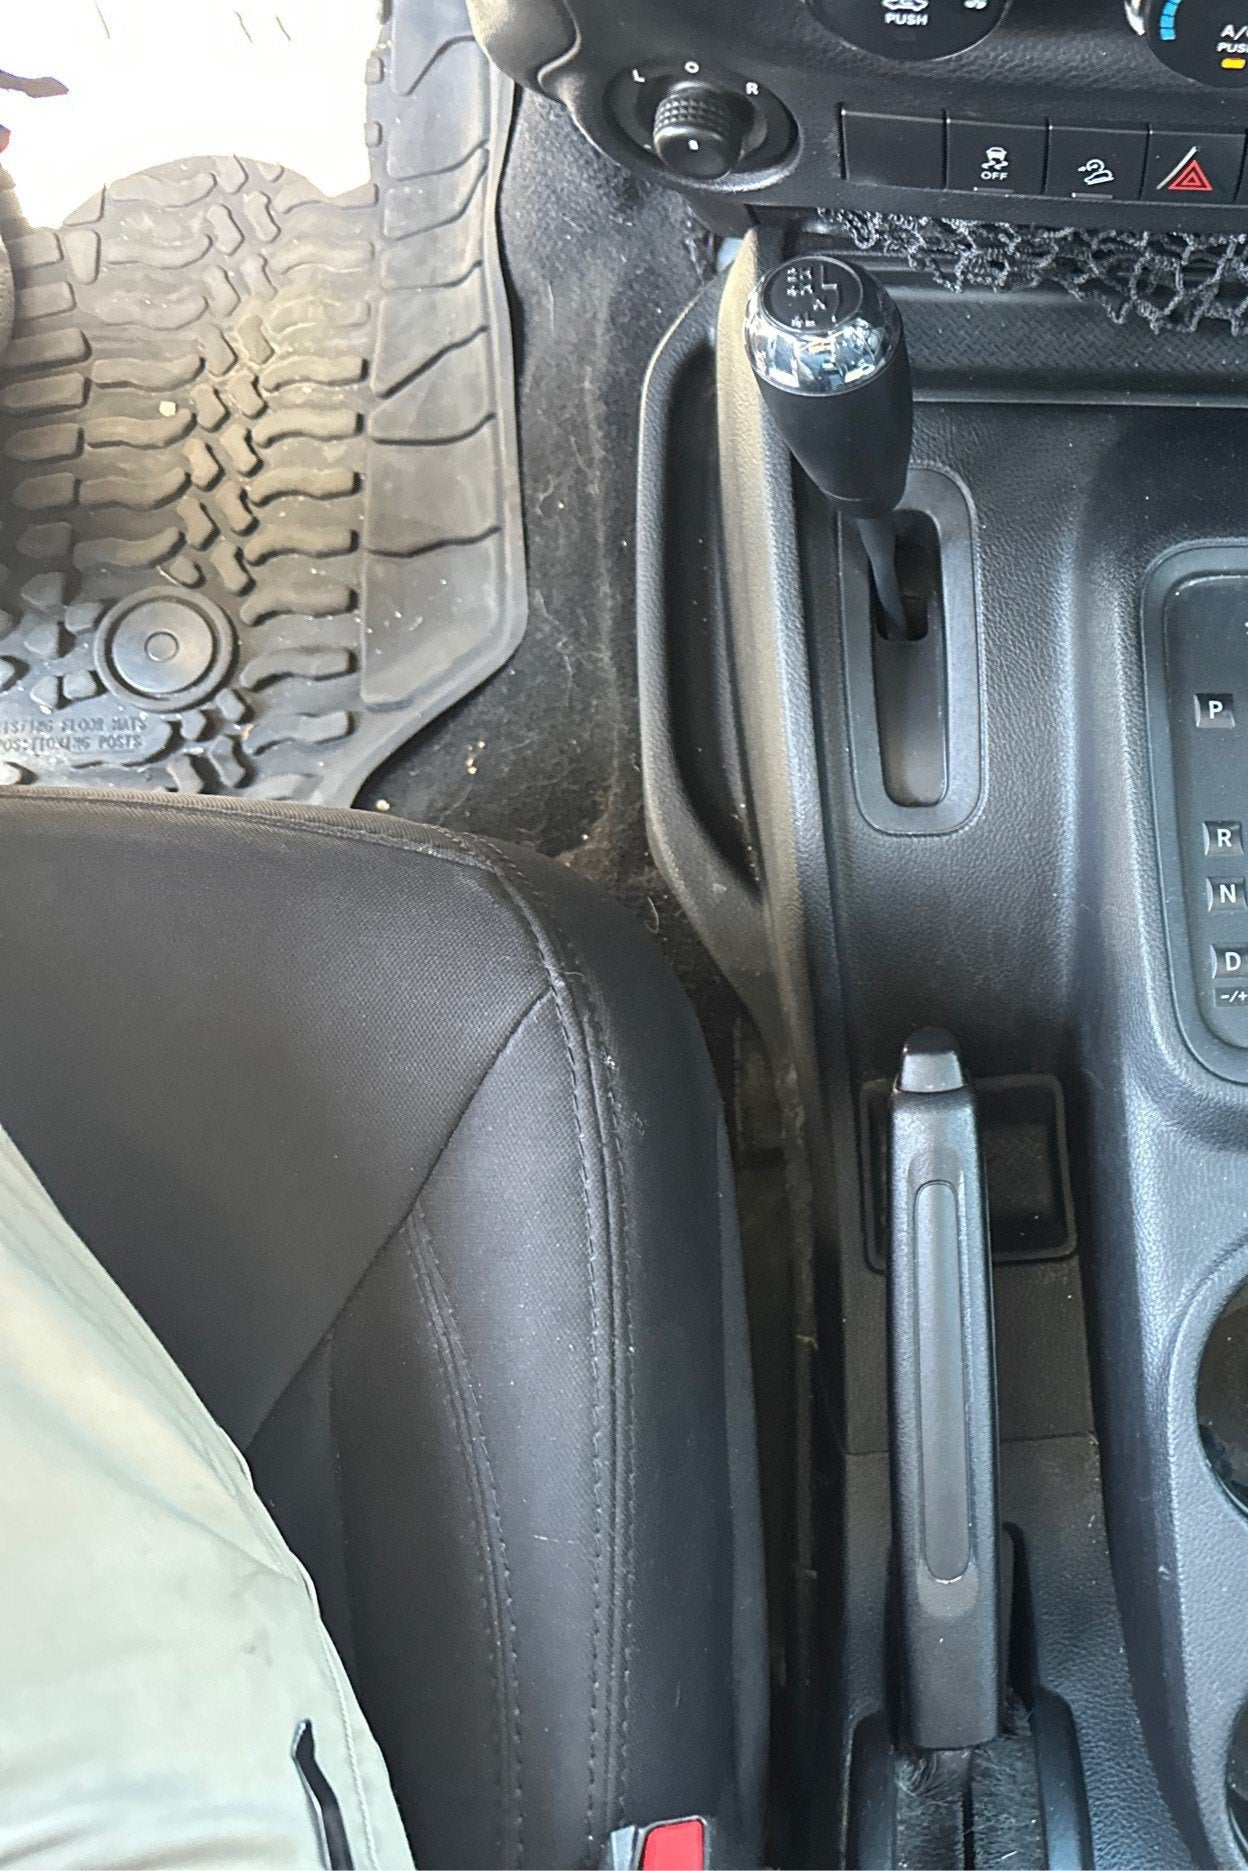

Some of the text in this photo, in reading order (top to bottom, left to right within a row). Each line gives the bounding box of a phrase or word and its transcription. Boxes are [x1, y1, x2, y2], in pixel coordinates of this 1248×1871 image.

[885, 12, 928, 26] PUSH
[632, 69, 645, 82] L
[745, 82, 759, 95] R
[981, 171, 1009, 180] OFF
[1208, 700, 1223, 719] P
[99, 734, 142, 749] POSTS
[1217, 828, 1232, 848] R
[1220, 884, 1236, 904] N
[1225, 951, 1241, 971] D
